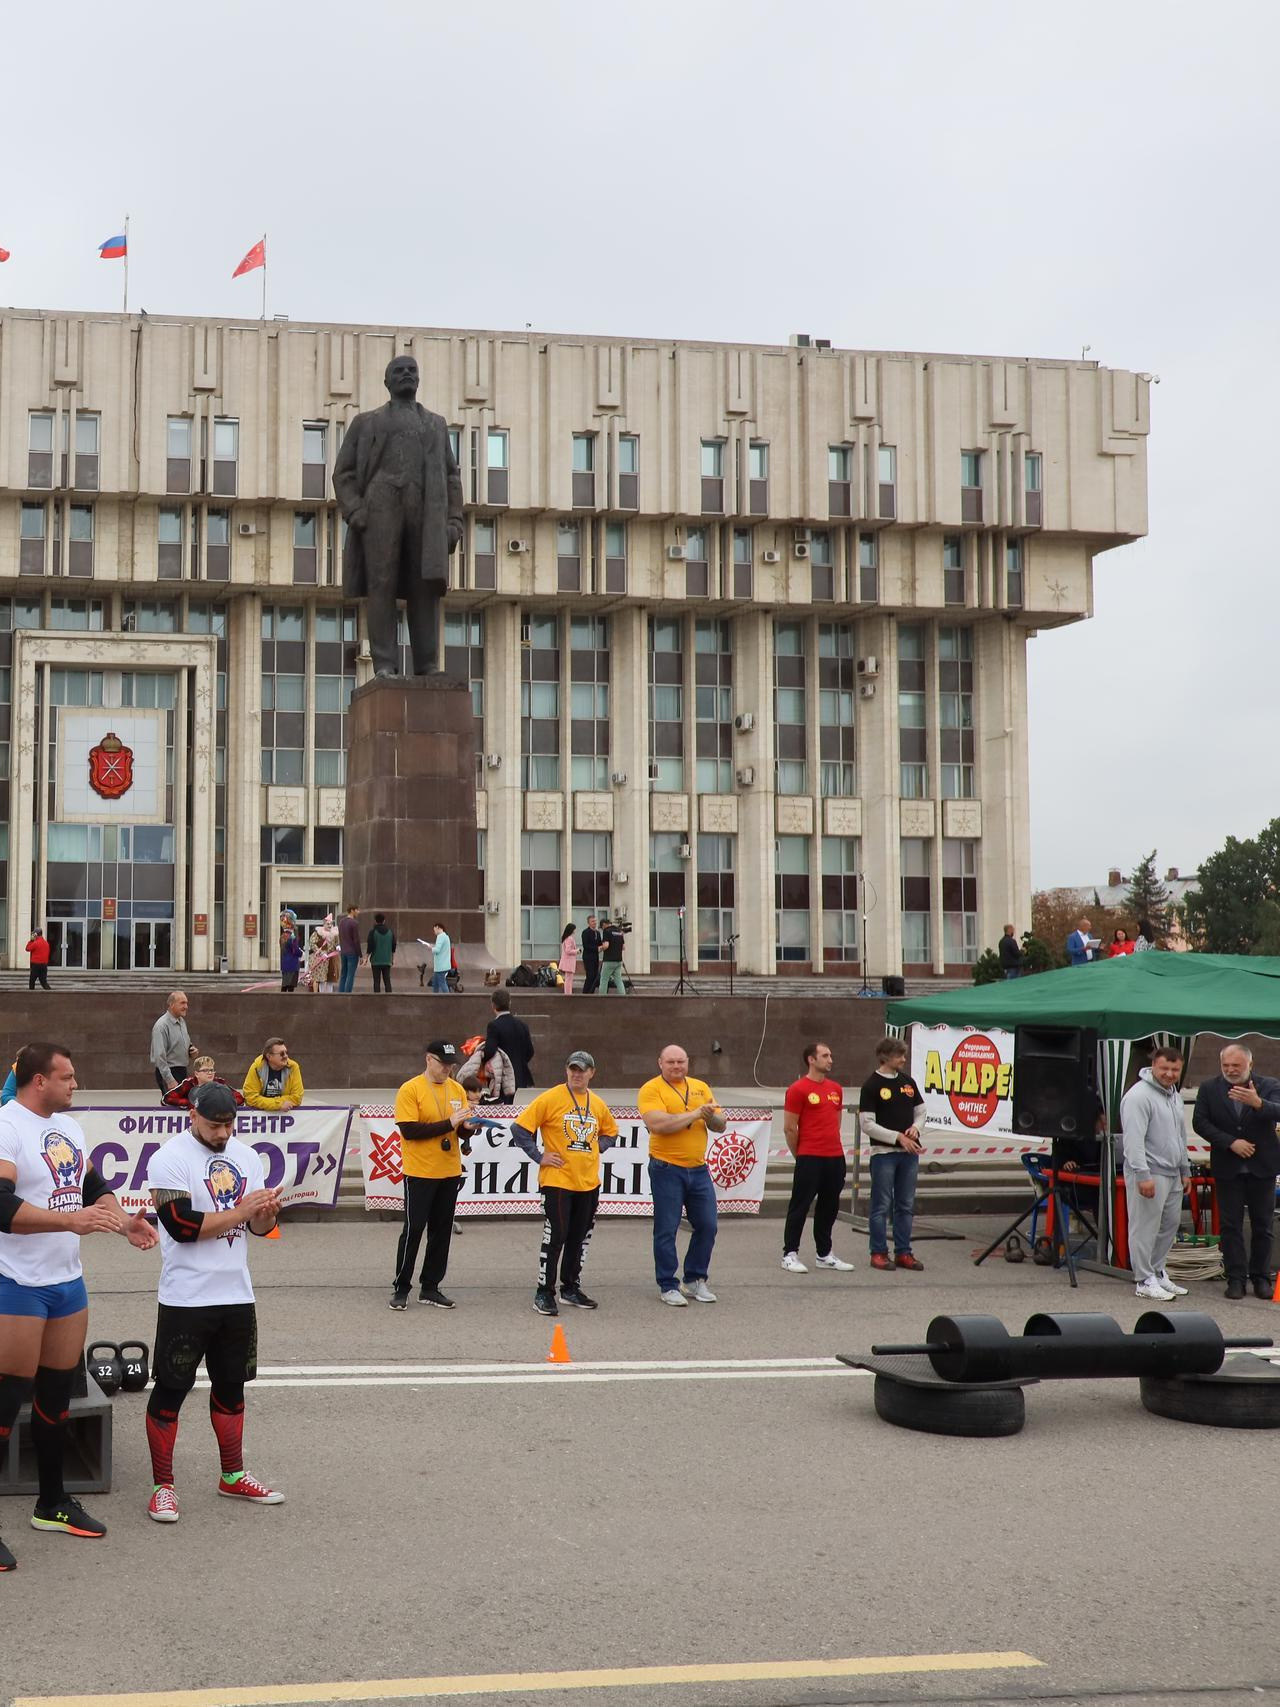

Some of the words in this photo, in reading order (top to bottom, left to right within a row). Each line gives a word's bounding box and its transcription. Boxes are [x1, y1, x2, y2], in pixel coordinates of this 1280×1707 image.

[924, 1050, 1014, 1101] АНДРЕ
[958, 1102, 988, 1114] ФИТНЕС
[98, 1366, 113, 1376] 32
[127, 1363, 142, 1375] 24
